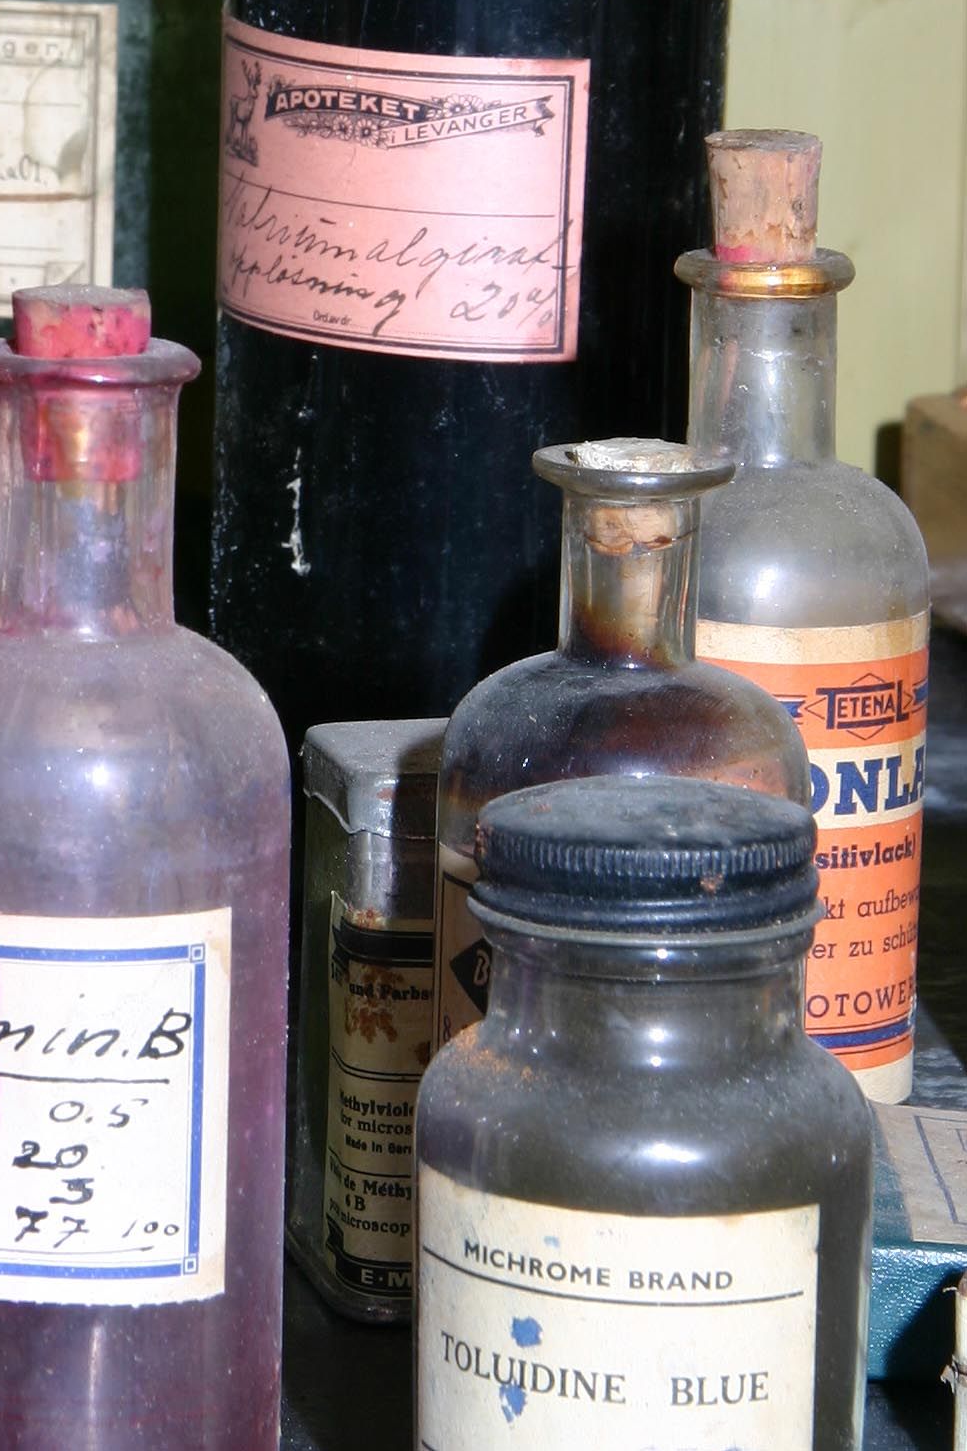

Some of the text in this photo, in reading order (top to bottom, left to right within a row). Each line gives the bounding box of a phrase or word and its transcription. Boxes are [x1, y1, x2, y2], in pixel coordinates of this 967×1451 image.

[274, 91, 421, 121] APOTEKET
[404, 104, 528, 142] LEVANGER
[816, 680, 909, 729] TETENAL
[849, 941, 873, 957] zu
[11, 1140, 89, 1170] 20
[344, 1175, 356, 1191] de
[354, 1194, 366, 1212] B
[14, 1205, 90, 1249] 77
[121, 1219, 180, 1237] 100
[464, 1239, 734, 1291] MICHROME BRAND
[440, 1330, 770, 1407] TOLUIDINE BLUE
